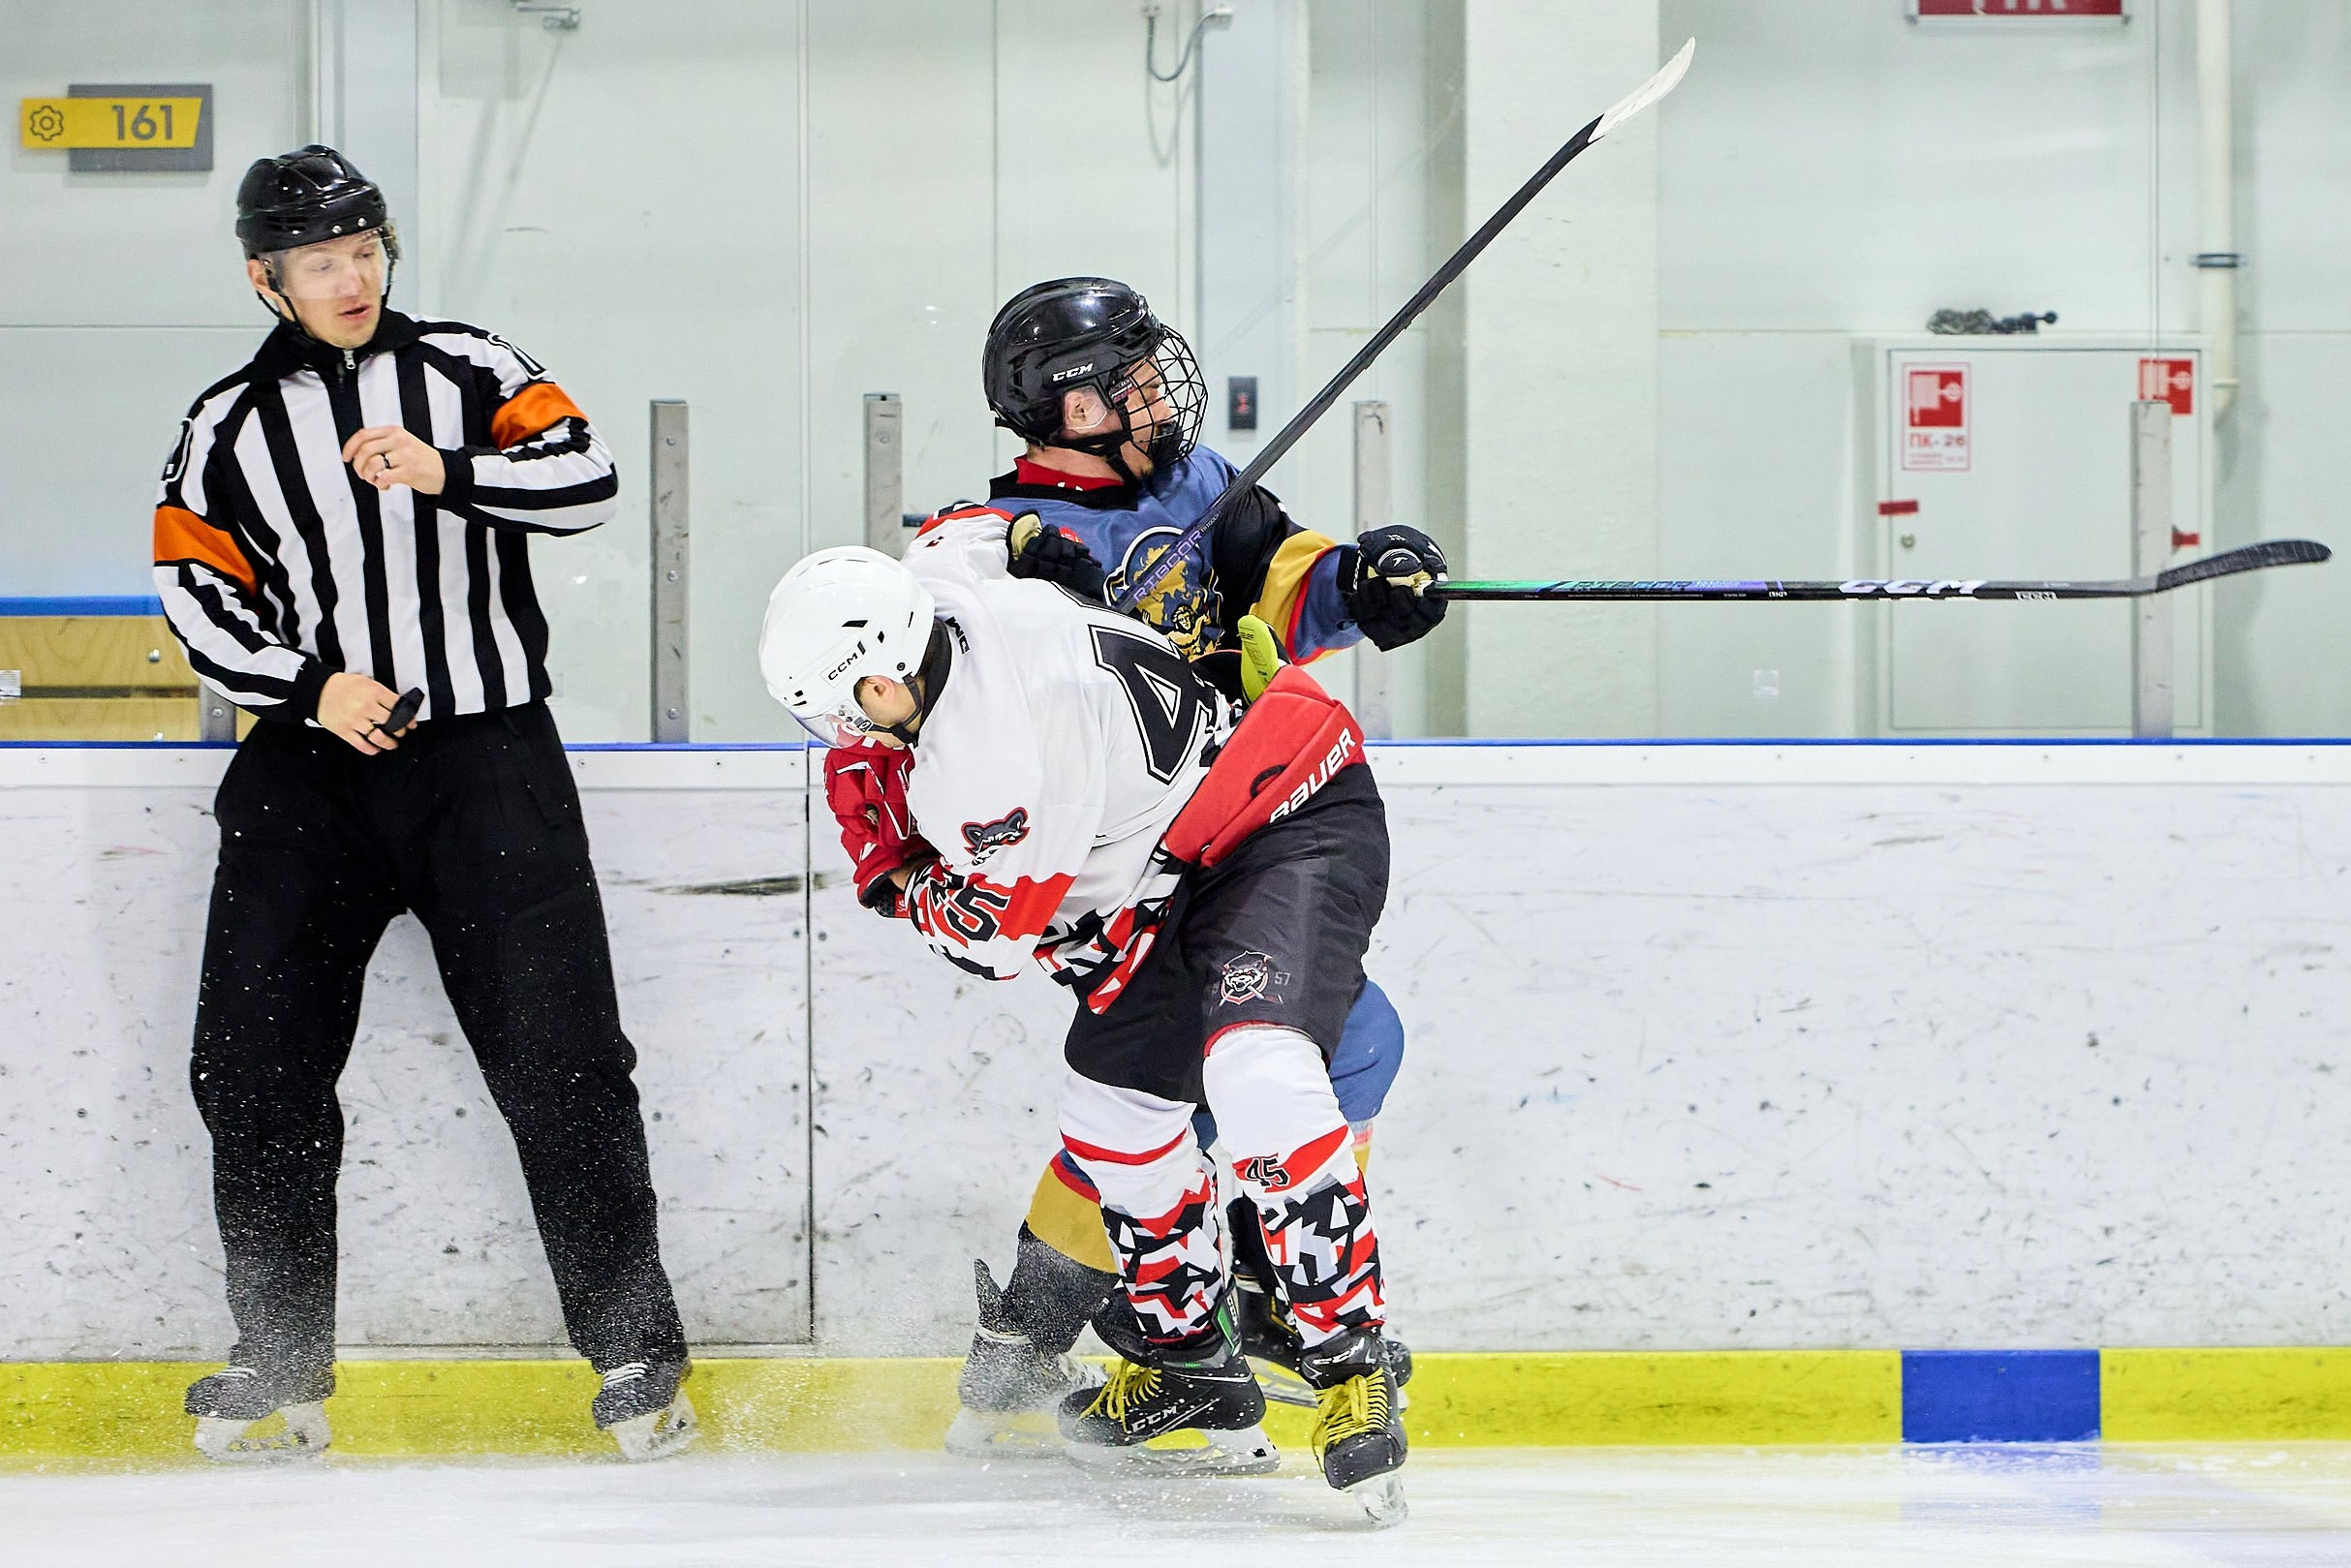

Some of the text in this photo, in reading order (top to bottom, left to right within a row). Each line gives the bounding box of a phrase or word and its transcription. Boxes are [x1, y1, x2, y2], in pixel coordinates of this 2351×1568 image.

[111, 105, 172, 140] 161
[1052, 362, 1095, 382] CCM
[1839, 579, 1986, 595] CCM
[827, 653, 858, 681] CCM
[1246, 1157, 1289, 1187] 45
[1312, 1337, 1366, 1366] CCM
[1131, 1404, 1177, 1432] CCM
